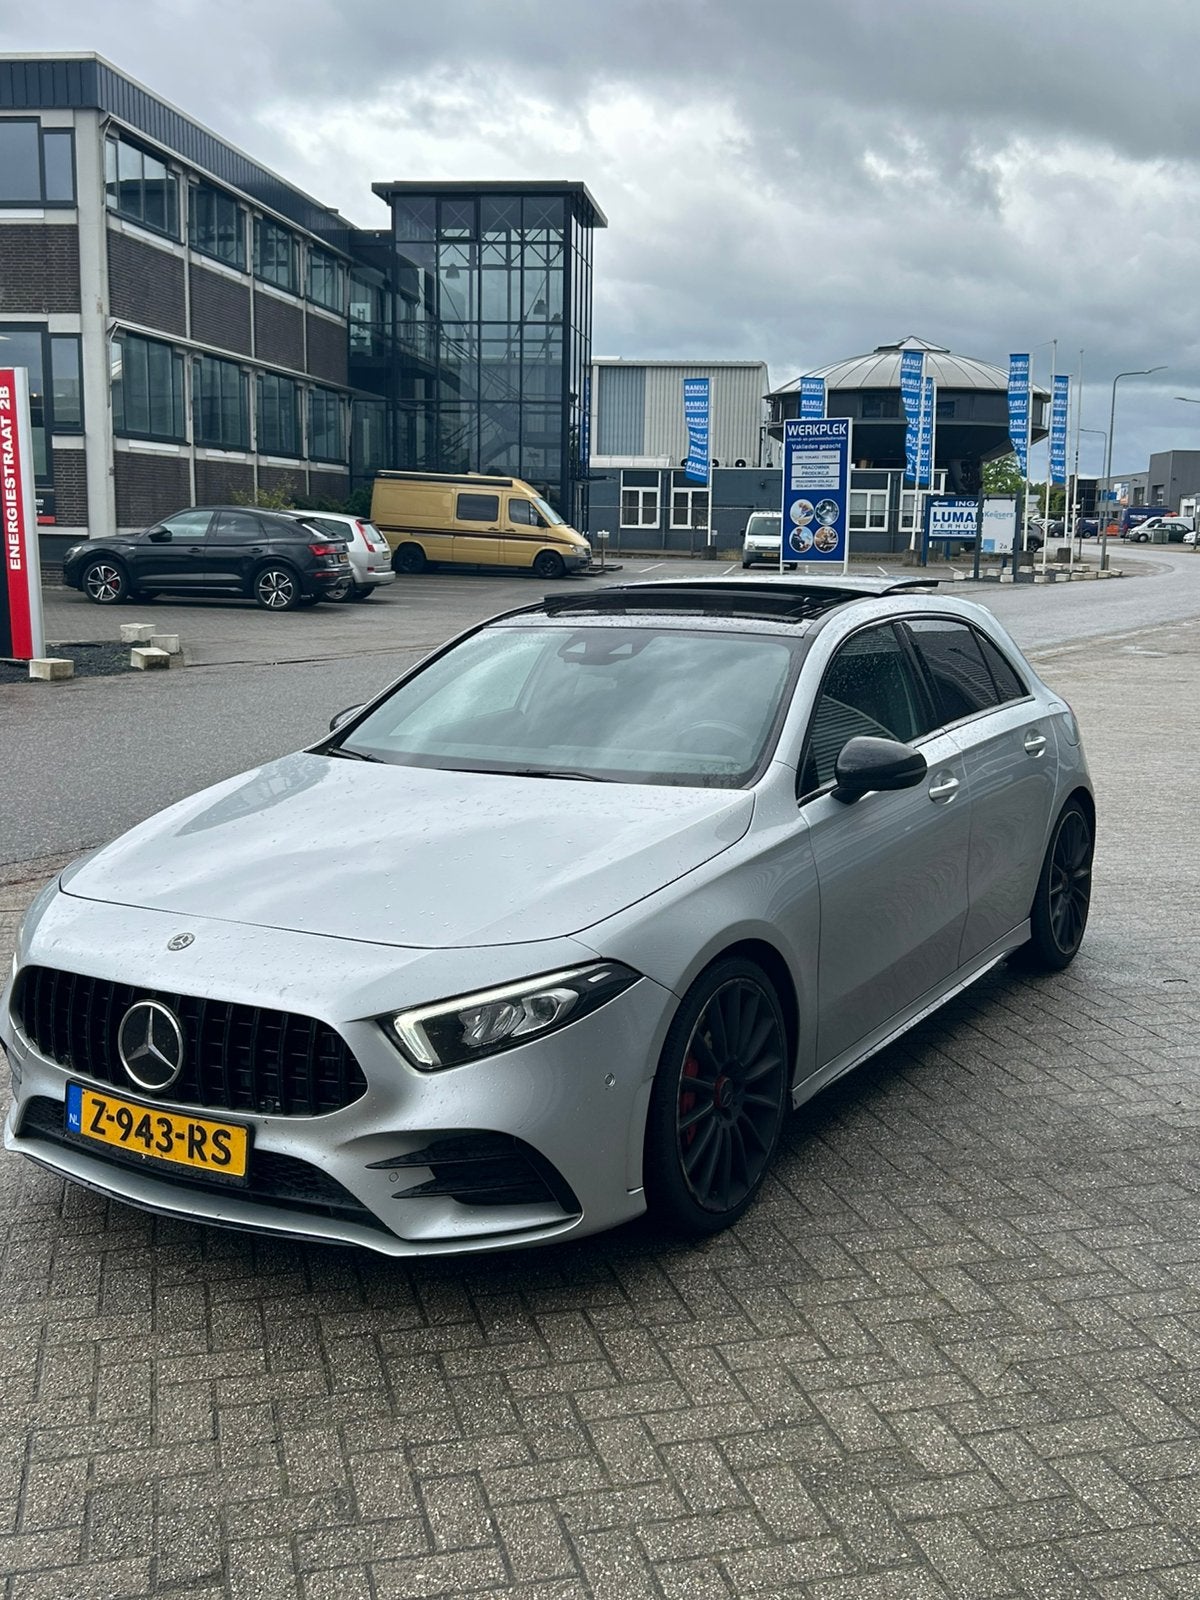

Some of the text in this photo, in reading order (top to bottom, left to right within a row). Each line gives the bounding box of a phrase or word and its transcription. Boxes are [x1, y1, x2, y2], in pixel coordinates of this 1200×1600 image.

[787, 423, 847, 436] WERKPLEK
[0, 385, 21, 570] ENERGIESTRAAT 2B
[933, 511, 977, 523] LUMA
[69, 1113, 79, 1126] NL
[90, 1098, 232, 1166] Z-943-RS
